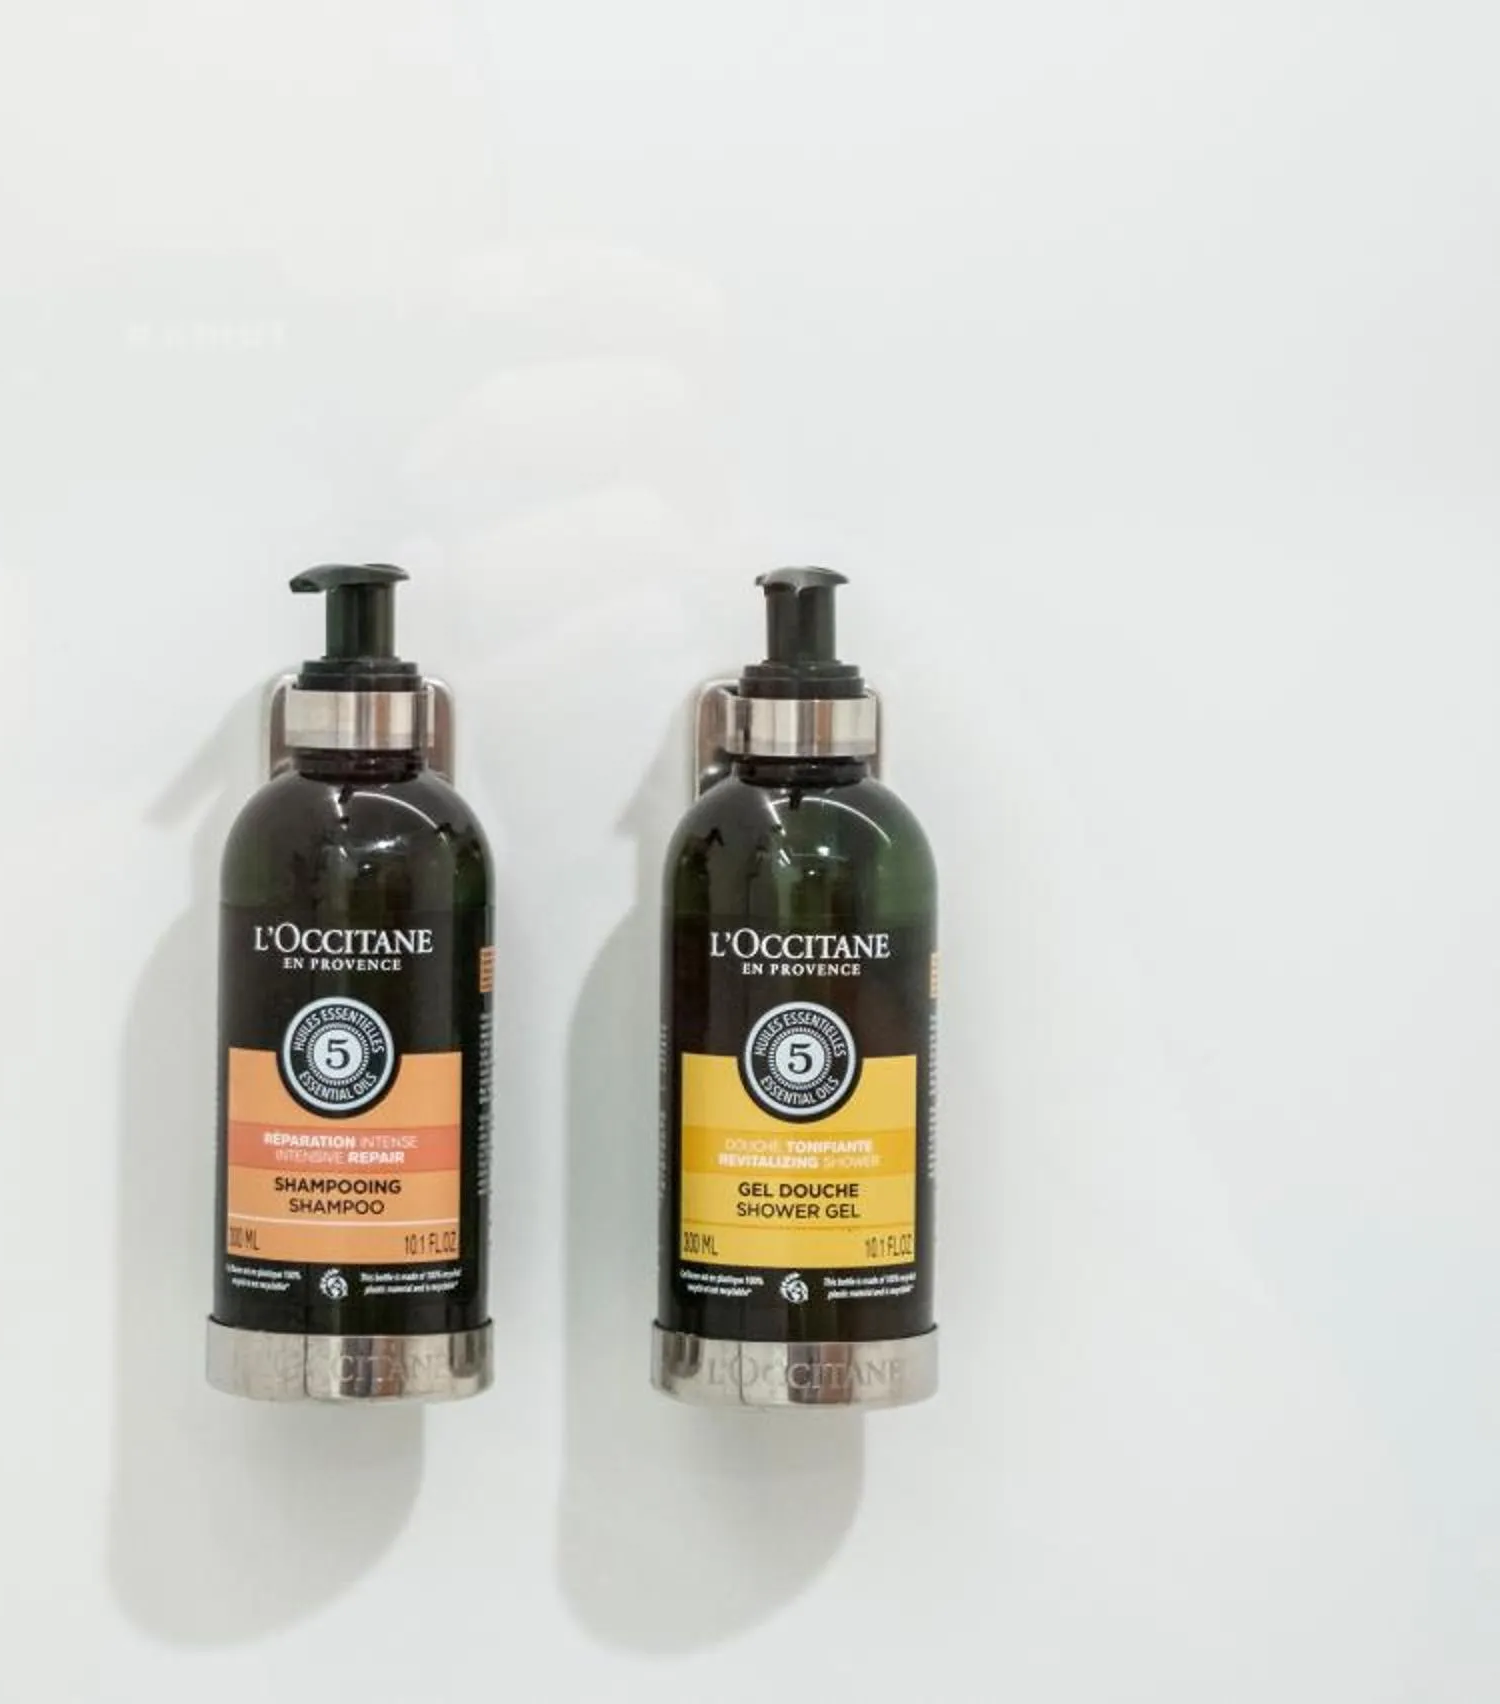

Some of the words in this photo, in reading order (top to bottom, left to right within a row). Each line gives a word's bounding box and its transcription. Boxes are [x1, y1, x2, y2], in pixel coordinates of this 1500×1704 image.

[253, 921, 434, 955] L'OCCITANE
[709, 927, 891, 959] L'OCCITANE
[283, 957, 304, 970] EN
[310, 957, 403, 971] PROVENCE
[741, 962, 764, 976] EN
[770, 963, 861, 977] PROVENCE
[293, 1012, 321, 1052] HUILES
[320, 1007, 385, 1054] ESSENTIELLES
[754, 1017, 784, 1057] HUILES
[781, 1011, 847, 1058] ESSENTIELLES
[325, 1039, 351, 1070] 5
[787, 1043, 813, 1075] 5
[299, 1070, 354, 1101] ESSENTIAL
[353, 1071, 378, 1096] OILS
[760, 1075, 816, 1105] ESSENTIAL
[815, 1075, 840, 1100] OILS
[360, 1134, 419, 1149] INTENSE
[787, 1139, 874, 1153] TONIFIANTE
[275, 1150, 345, 1164] INTENSIVE
[347, 1151, 405, 1165] REPAIR
[717, 1153, 819, 1169] REVITALIZING
[823, 1154, 881, 1168] SHOWER
[274, 1177, 403, 1195] SHAMPOOING
[738, 1181, 774, 1197] GEL
[779, 1182, 861, 1199] DOUCHE
[289, 1197, 385, 1215] SHAMPOO
[736, 1201, 821, 1219] SHOWER
[825, 1203, 861, 1219] GEL
[701, 1233, 719, 1256] ML
